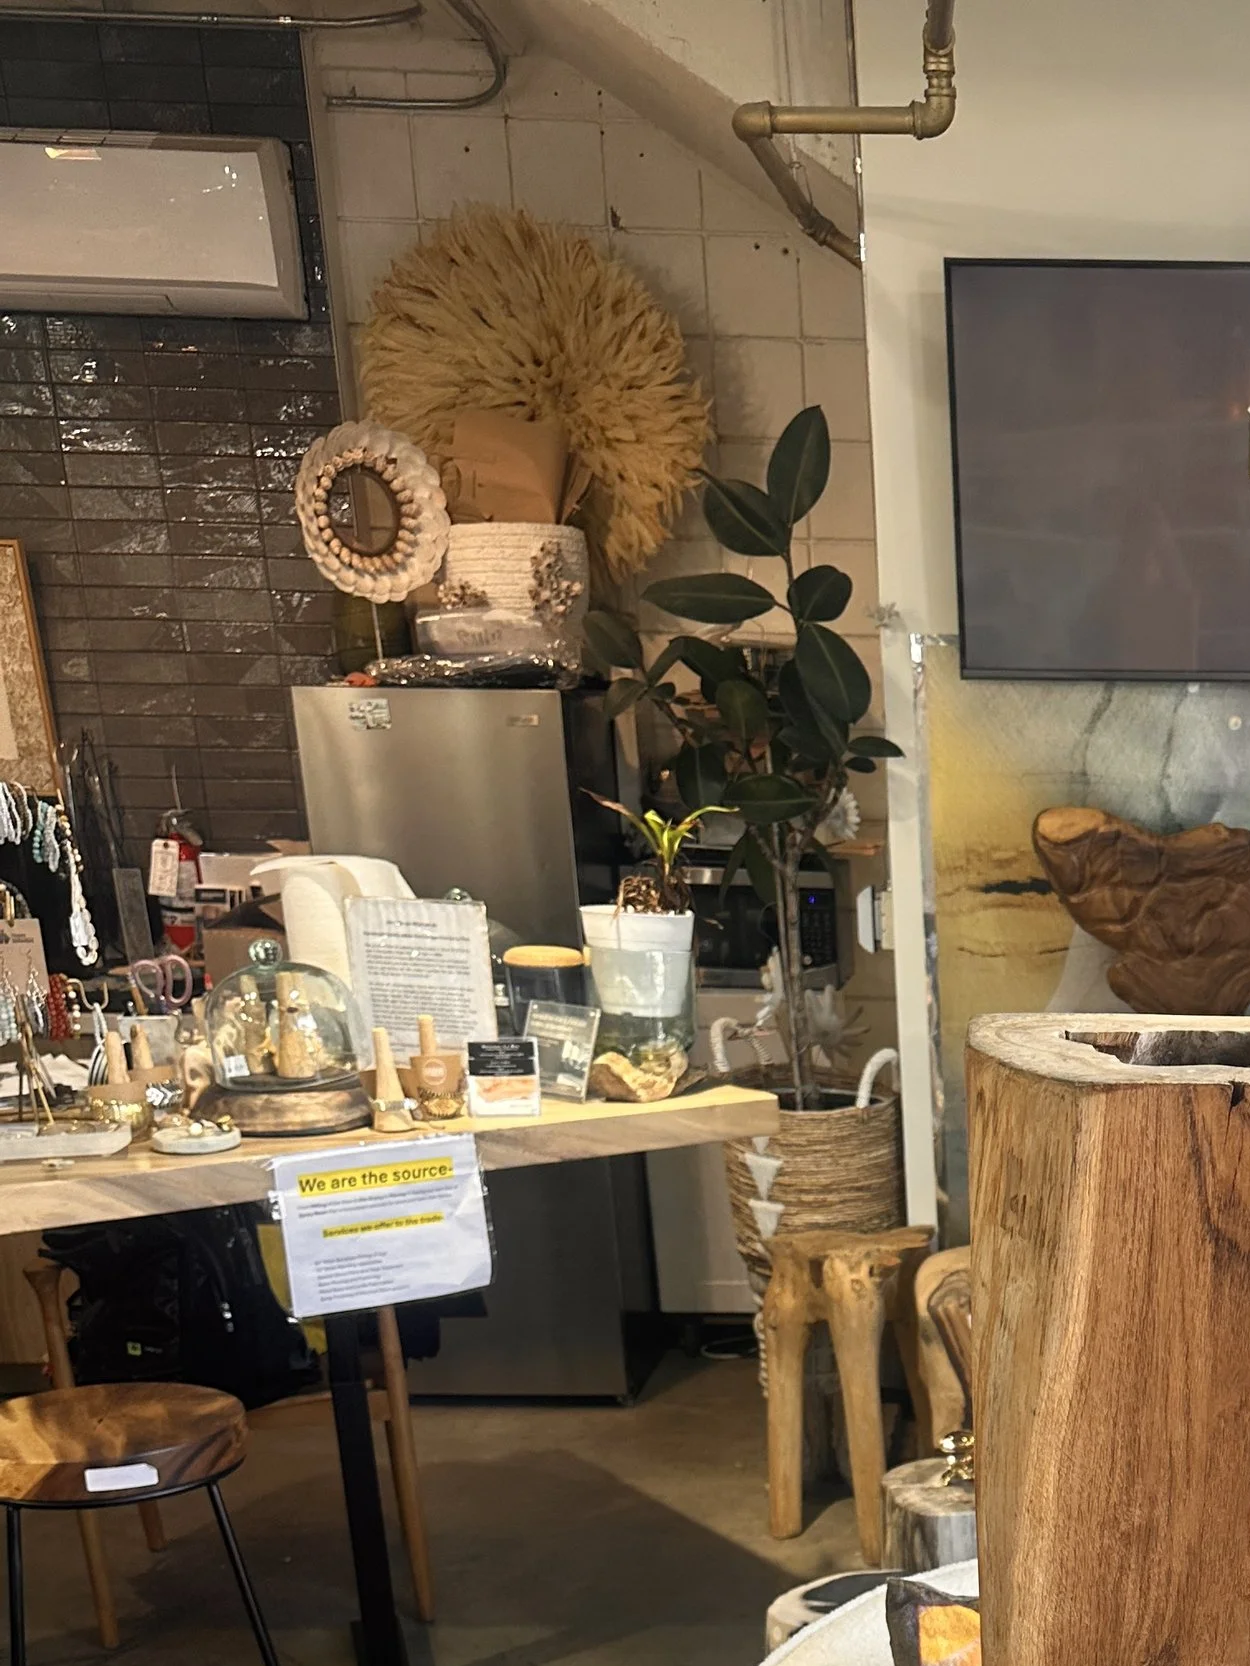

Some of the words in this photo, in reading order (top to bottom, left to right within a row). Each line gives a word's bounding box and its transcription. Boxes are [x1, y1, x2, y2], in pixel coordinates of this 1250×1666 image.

[298, 1178, 326, 1193] We
[331, 1176, 357, 1190] are
[362, 1171, 388, 1185] the
[323, 1227, 359, 1238] Services
[360, 1224, 373, 1234] we
[374, 1221, 394, 1231] offer
[395, 1219, 405, 1227] to
[406, 1217, 419, 1226] the
